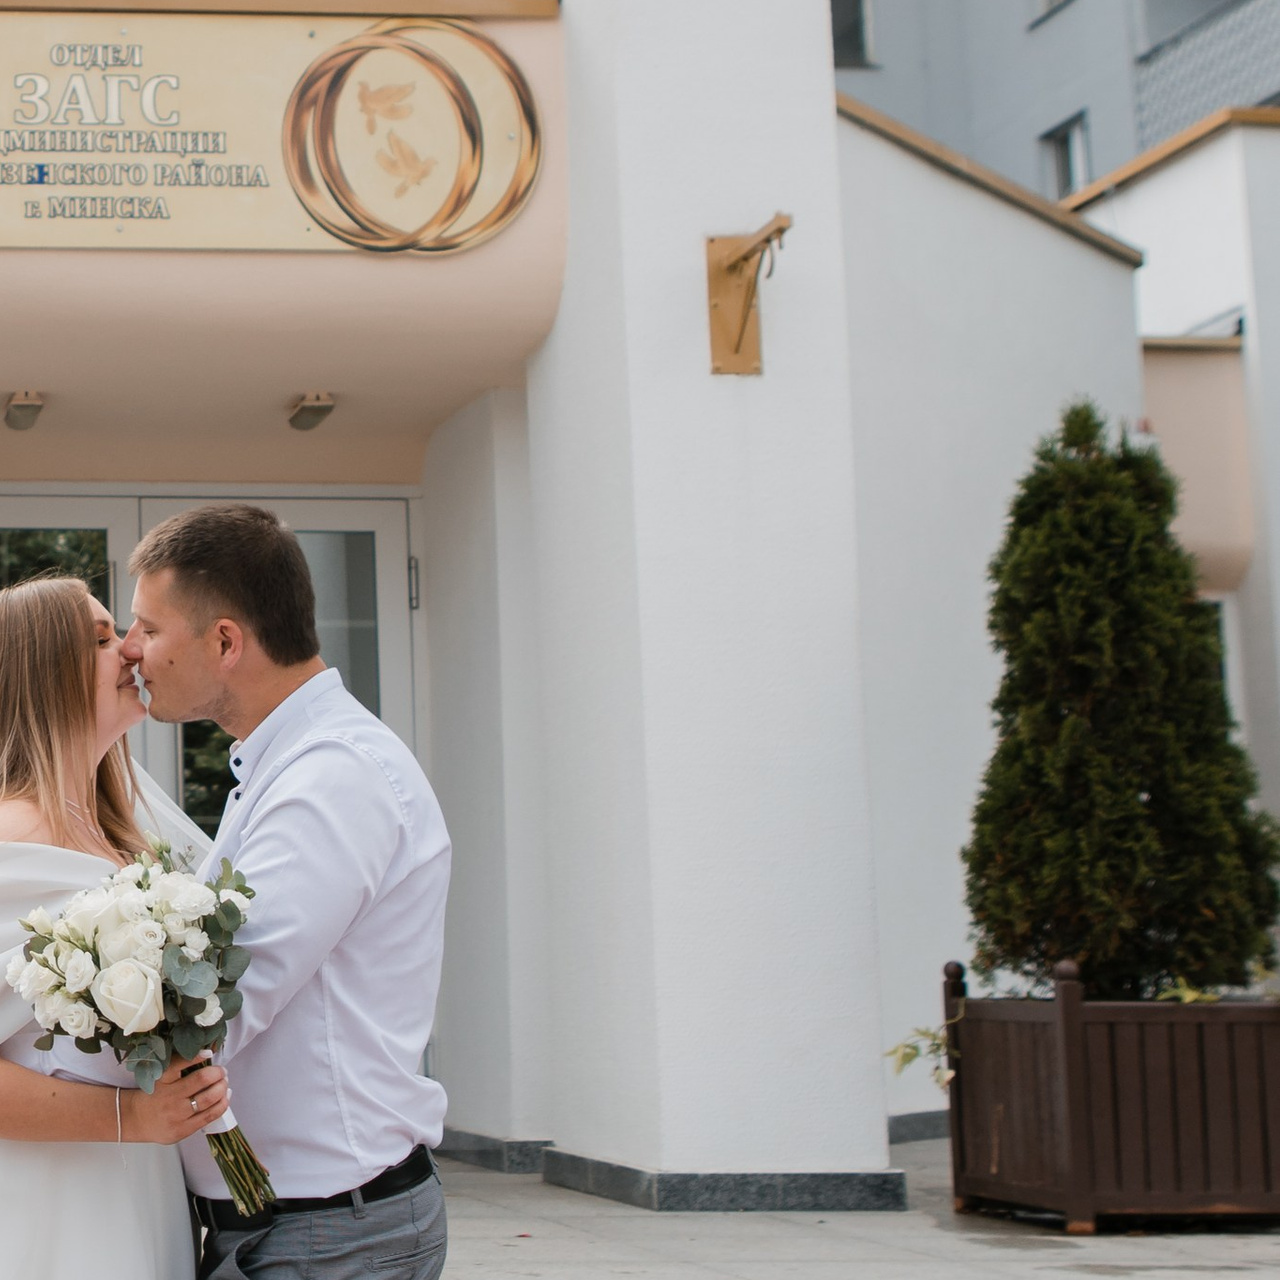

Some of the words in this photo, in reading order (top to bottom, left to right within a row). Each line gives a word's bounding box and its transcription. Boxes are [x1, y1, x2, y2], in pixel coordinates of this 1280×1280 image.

[50, 43, 142, 71] ОТДЕЛ
[13, 72, 180, 127] ЗАГС
[153, 158, 270, 187] РАЙОНА
[47, 196, 170, 220] МИНСКА
